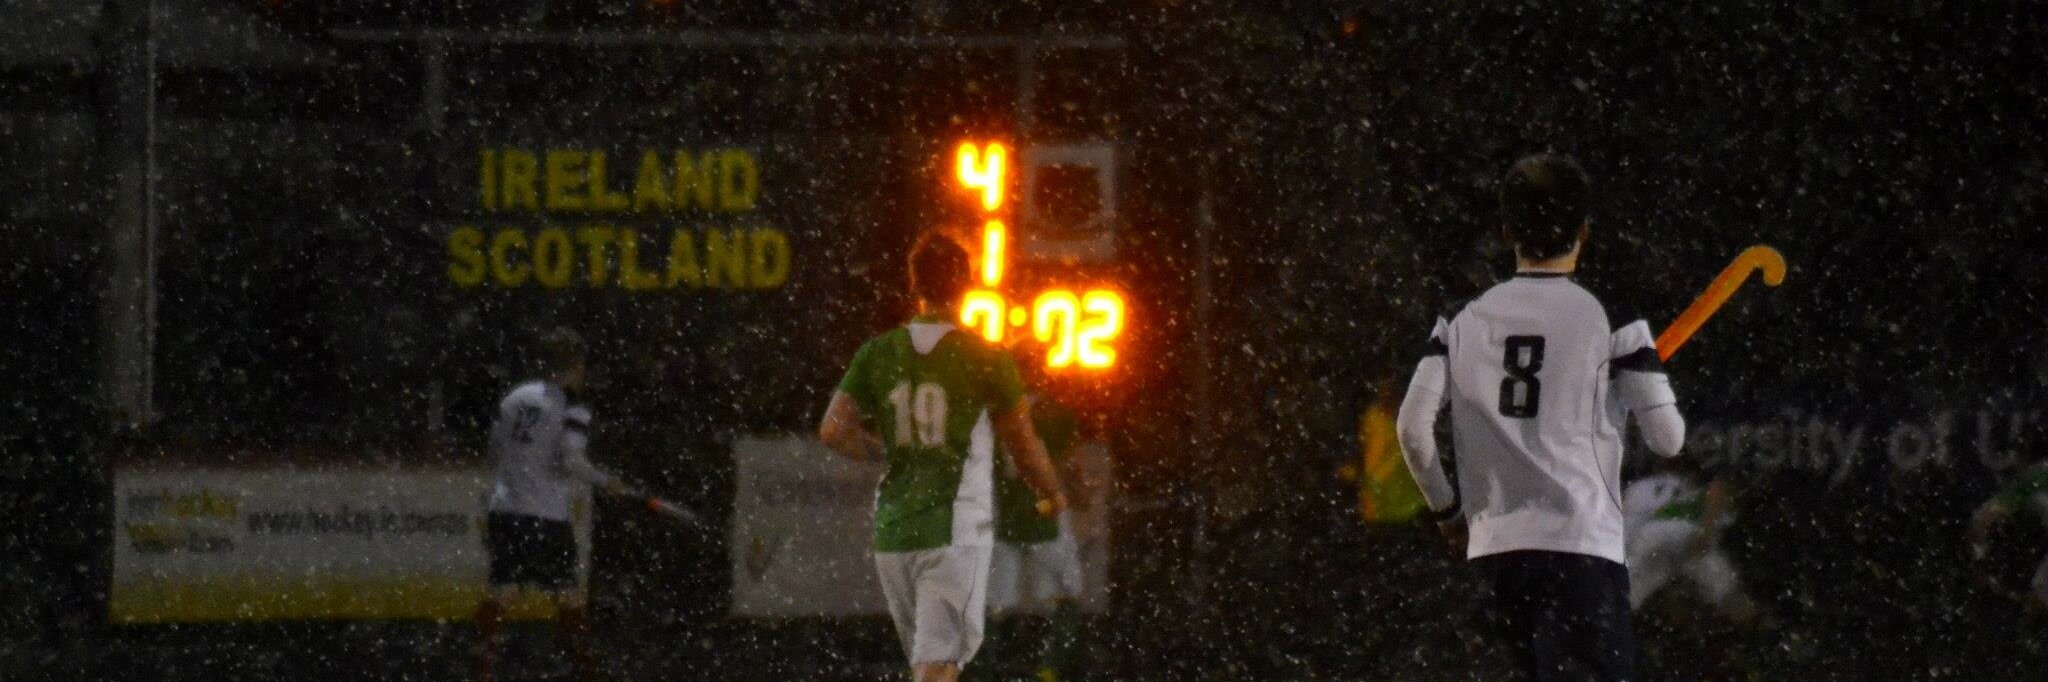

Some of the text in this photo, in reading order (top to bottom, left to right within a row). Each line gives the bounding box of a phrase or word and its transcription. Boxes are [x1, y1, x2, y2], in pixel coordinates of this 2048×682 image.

[480, 149, 760, 212] IRELAND
[956, 142, 1005, 211] 4
[448, 223, 792, 291] SCOTLAND
[981, 219, 1004, 287] 1
[1499, 335, 1545, 418] 8
[887, 380, 948, 447] 19
[1686, 408, 1866, 492] ersity
[1888, 406, 1956, 470] of
